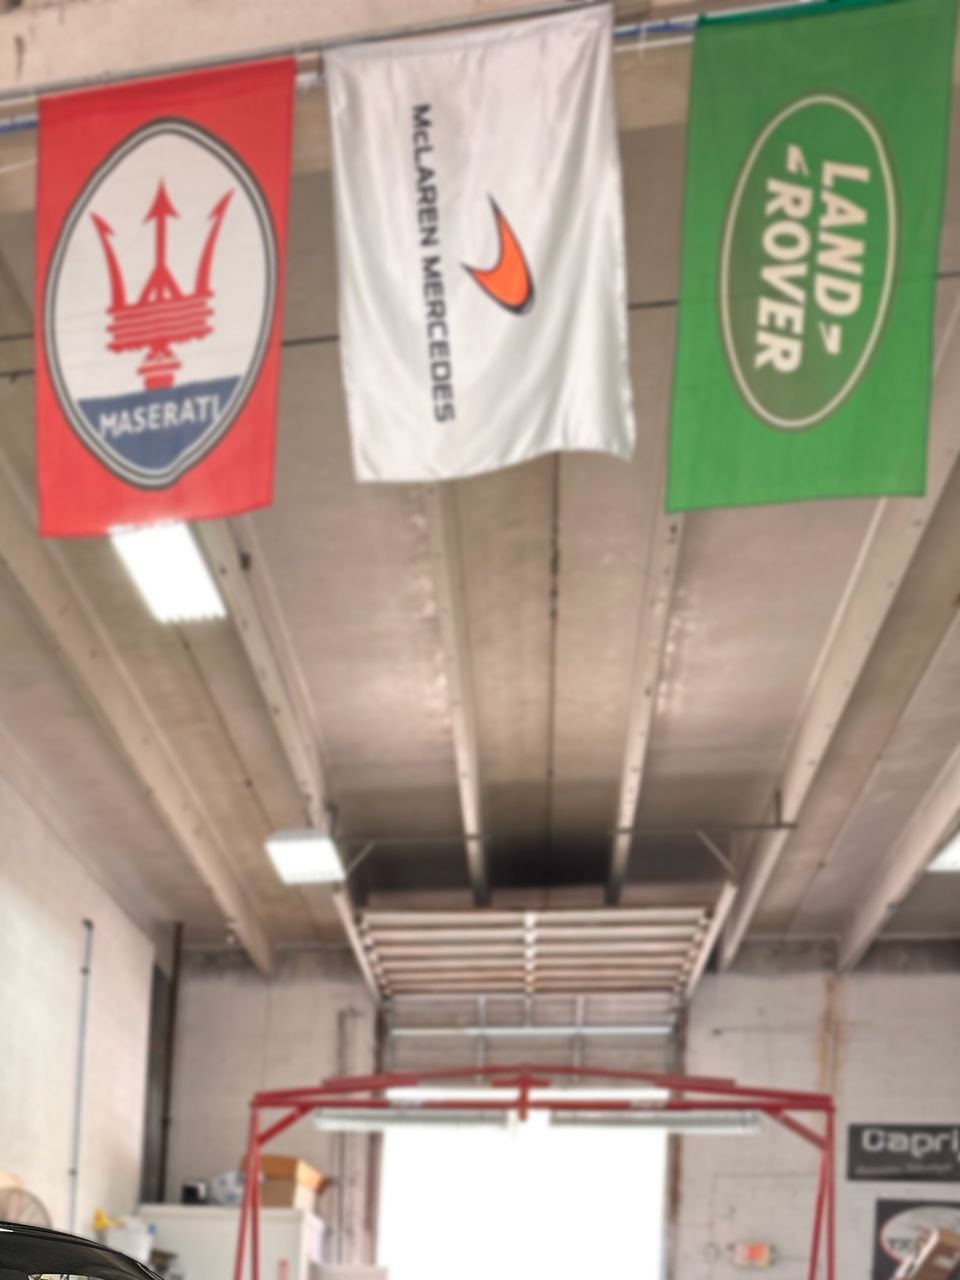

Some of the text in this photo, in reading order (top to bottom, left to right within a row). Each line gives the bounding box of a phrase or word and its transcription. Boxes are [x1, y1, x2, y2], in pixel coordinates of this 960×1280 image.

[410, 103, 457, 424] McLAREN MERCEDES
[754, 178, 814, 374] ROVER
[814, 161, 871, 317] LAND
[98, 393, 225, 440] MASERATI
[861, 1128, 960, 1159] Capri
